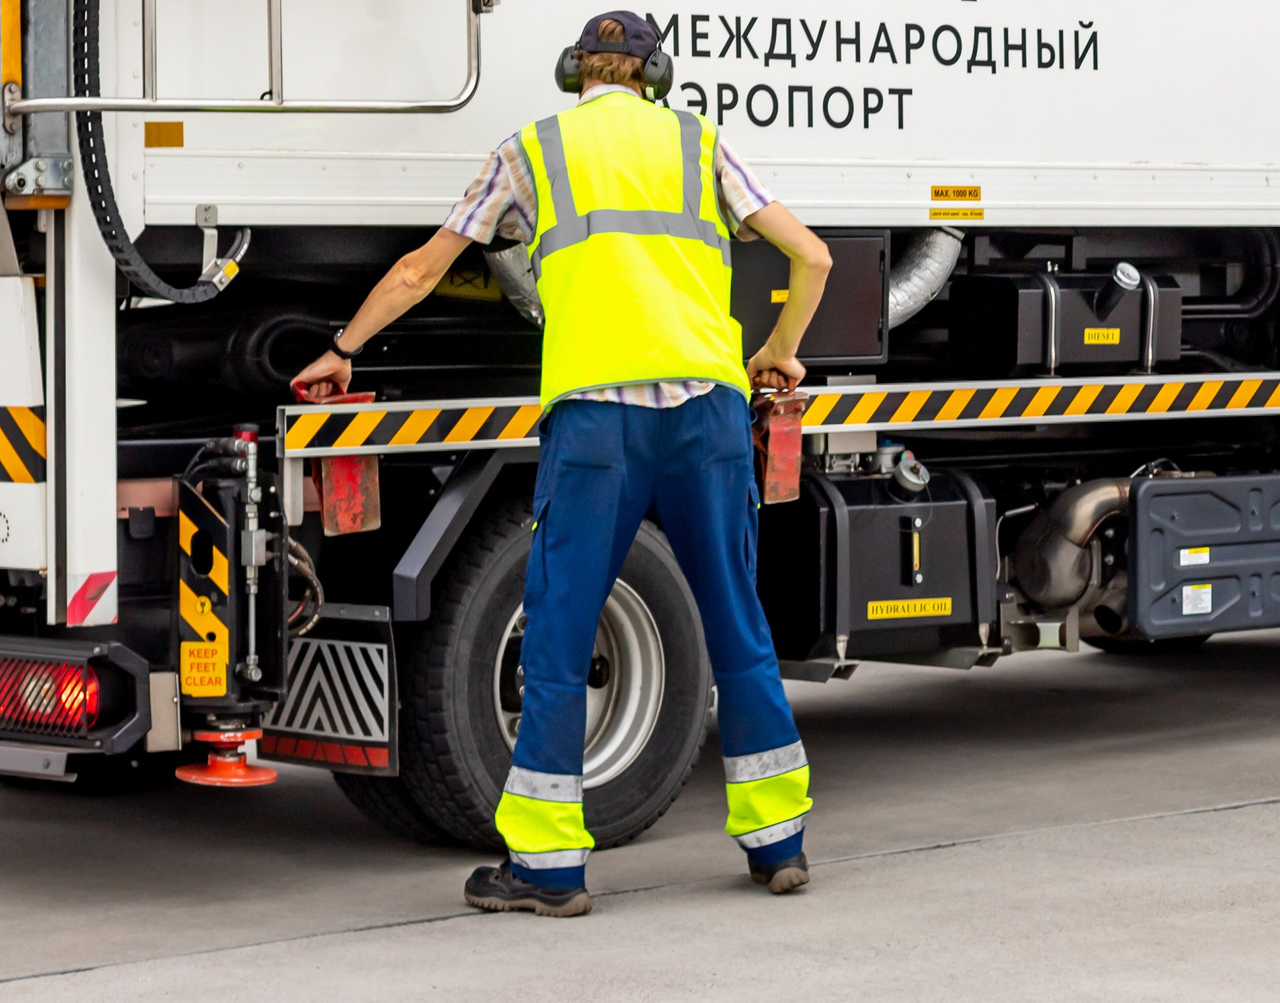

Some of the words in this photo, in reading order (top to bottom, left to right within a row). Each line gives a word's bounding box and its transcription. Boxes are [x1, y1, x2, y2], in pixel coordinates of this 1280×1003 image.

[645, 13, 1099, 74] МЕЖДУНАРОДНЫЙ
[654, 82, 913, 130] ЭРОПОРТ
[934, 189, 950, 198] MAX.
[952, 189, 967, 198] 1000
[969, 189, 979, 198] KG
[1087, 332, 1117, 341] DIESEL
[871, 603, 930, 615] HYDRAULIC
[932, 602, 950, 612] OIL
[188, 648, 218, 659] KEEP
[189, 662, 217, 673] FEET
[185, 676, 222, 687] CLEAR
